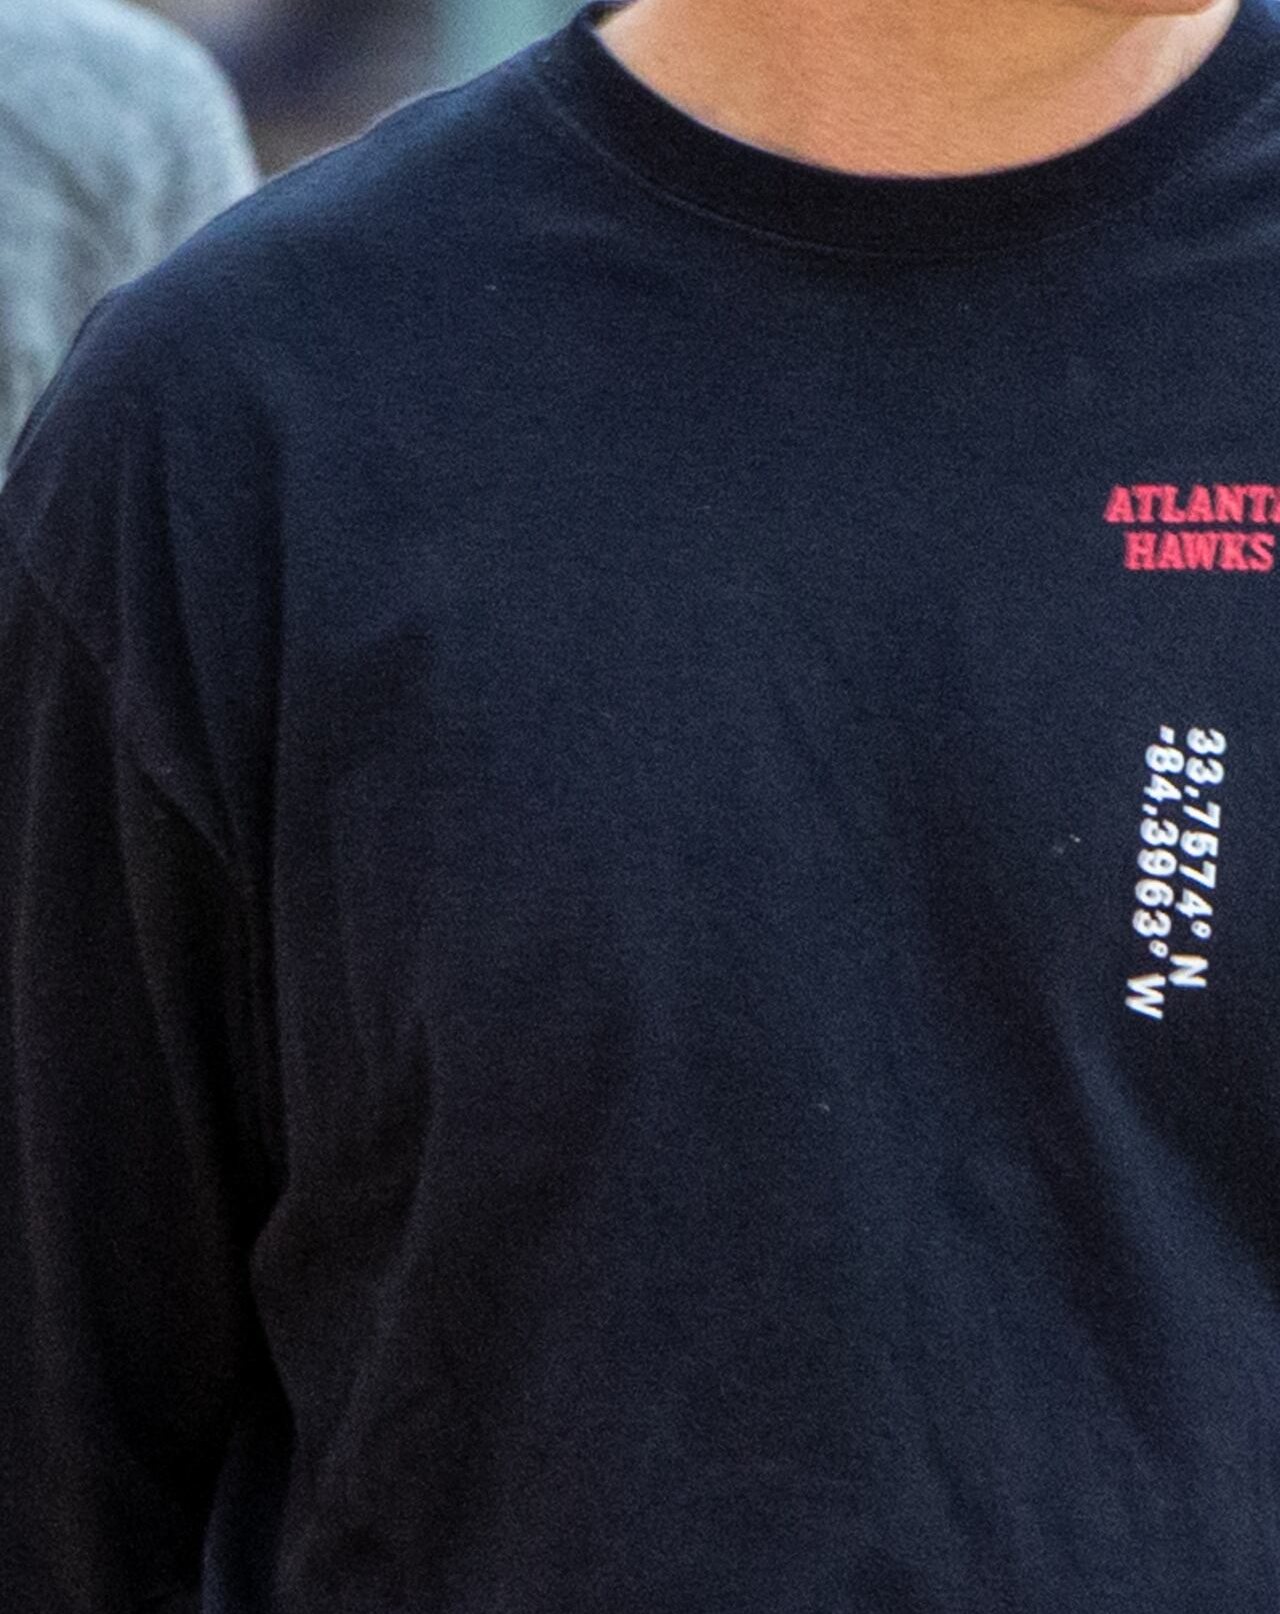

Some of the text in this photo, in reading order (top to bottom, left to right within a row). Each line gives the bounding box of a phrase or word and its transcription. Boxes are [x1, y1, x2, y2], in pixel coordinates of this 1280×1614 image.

[1123, 532, 1276, 572] HAWKS
[1168, 952, 1210, 989] N
[1125, 972, 1168, 1021] W
